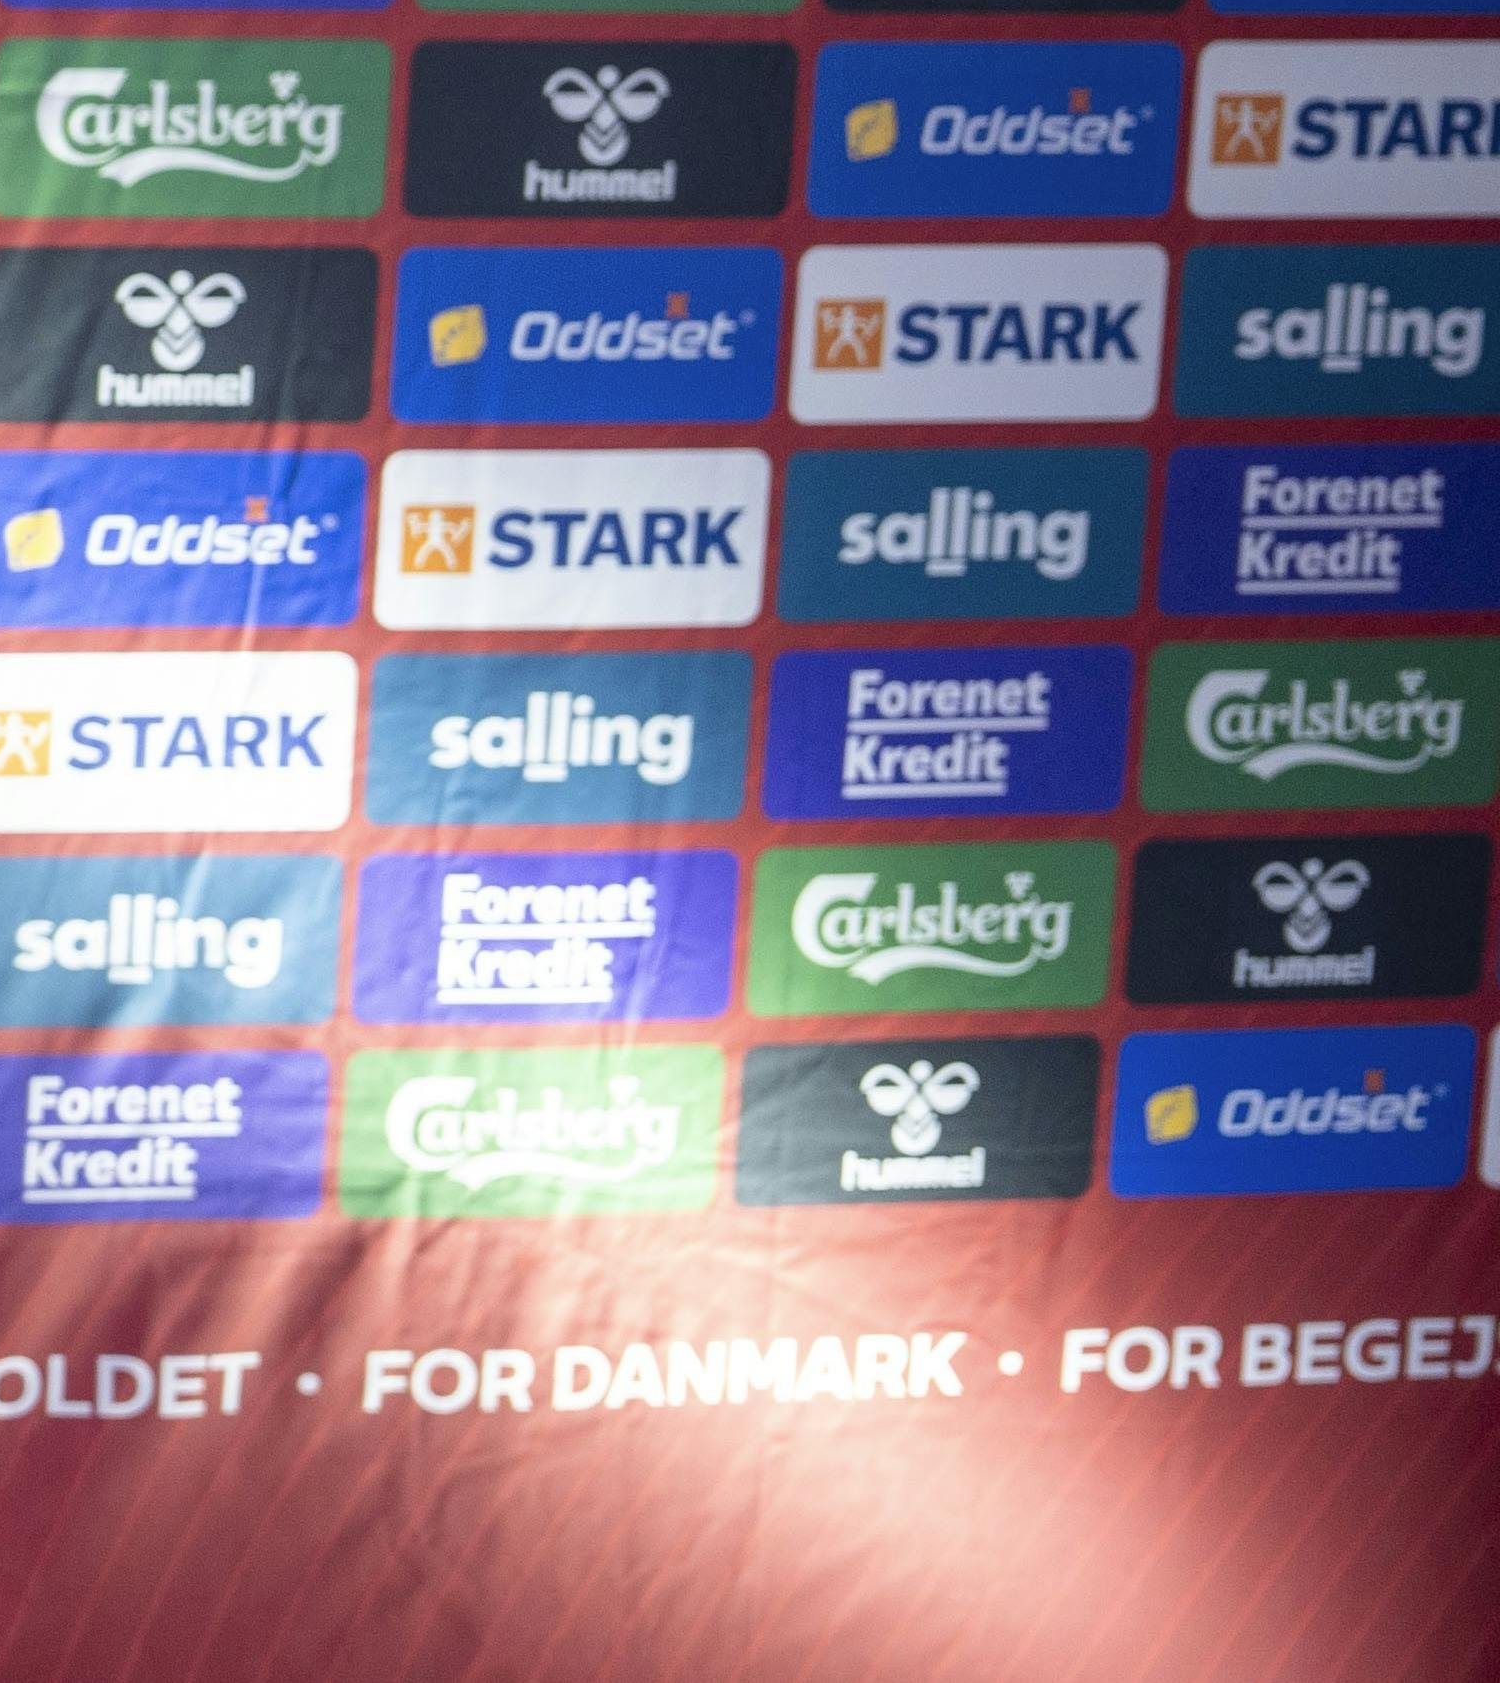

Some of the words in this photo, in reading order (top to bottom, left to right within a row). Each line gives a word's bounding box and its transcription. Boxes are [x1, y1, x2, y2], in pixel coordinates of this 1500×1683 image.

[35, 67, 341, 188] Carlsberg
[523, 161, 676, 202] hummel
[895, 301, 1141, 365] STARK
[1234, 283, 1484, 376] salling
[96, 364, 254, 408] hummel
[1239, 463, 1443, 516] Forenet
[487, 507, 744, 570] STARK
[1237, 529, 1398, 579] Kredit
[846, 666, 1048, 719] Forenet
[67, 713, 325, 772] STARK
[428, 691, 693, 785] salling
[1185, 669, 1462, 780] Carlsberg
[842, 731, 1005, 784] Kredit
[14, 888, 294, 992] salling
[791, 872, 1067, 985] Carlsberg
[1232, 947, 1375, 987] hummel
[23, 1072, 243, 1126] Forenet
[23, 1137, 198, 1189] Kredit
[838, 1147, 985, 1193] hummel
[362, 1347, 537, 1414] FOR
[551, 1330, 967, 1412] DANMARK
[1060, 1325, 1222, 1394] FOR
[1241, 1315, 1500, 1386] BEGEJ
